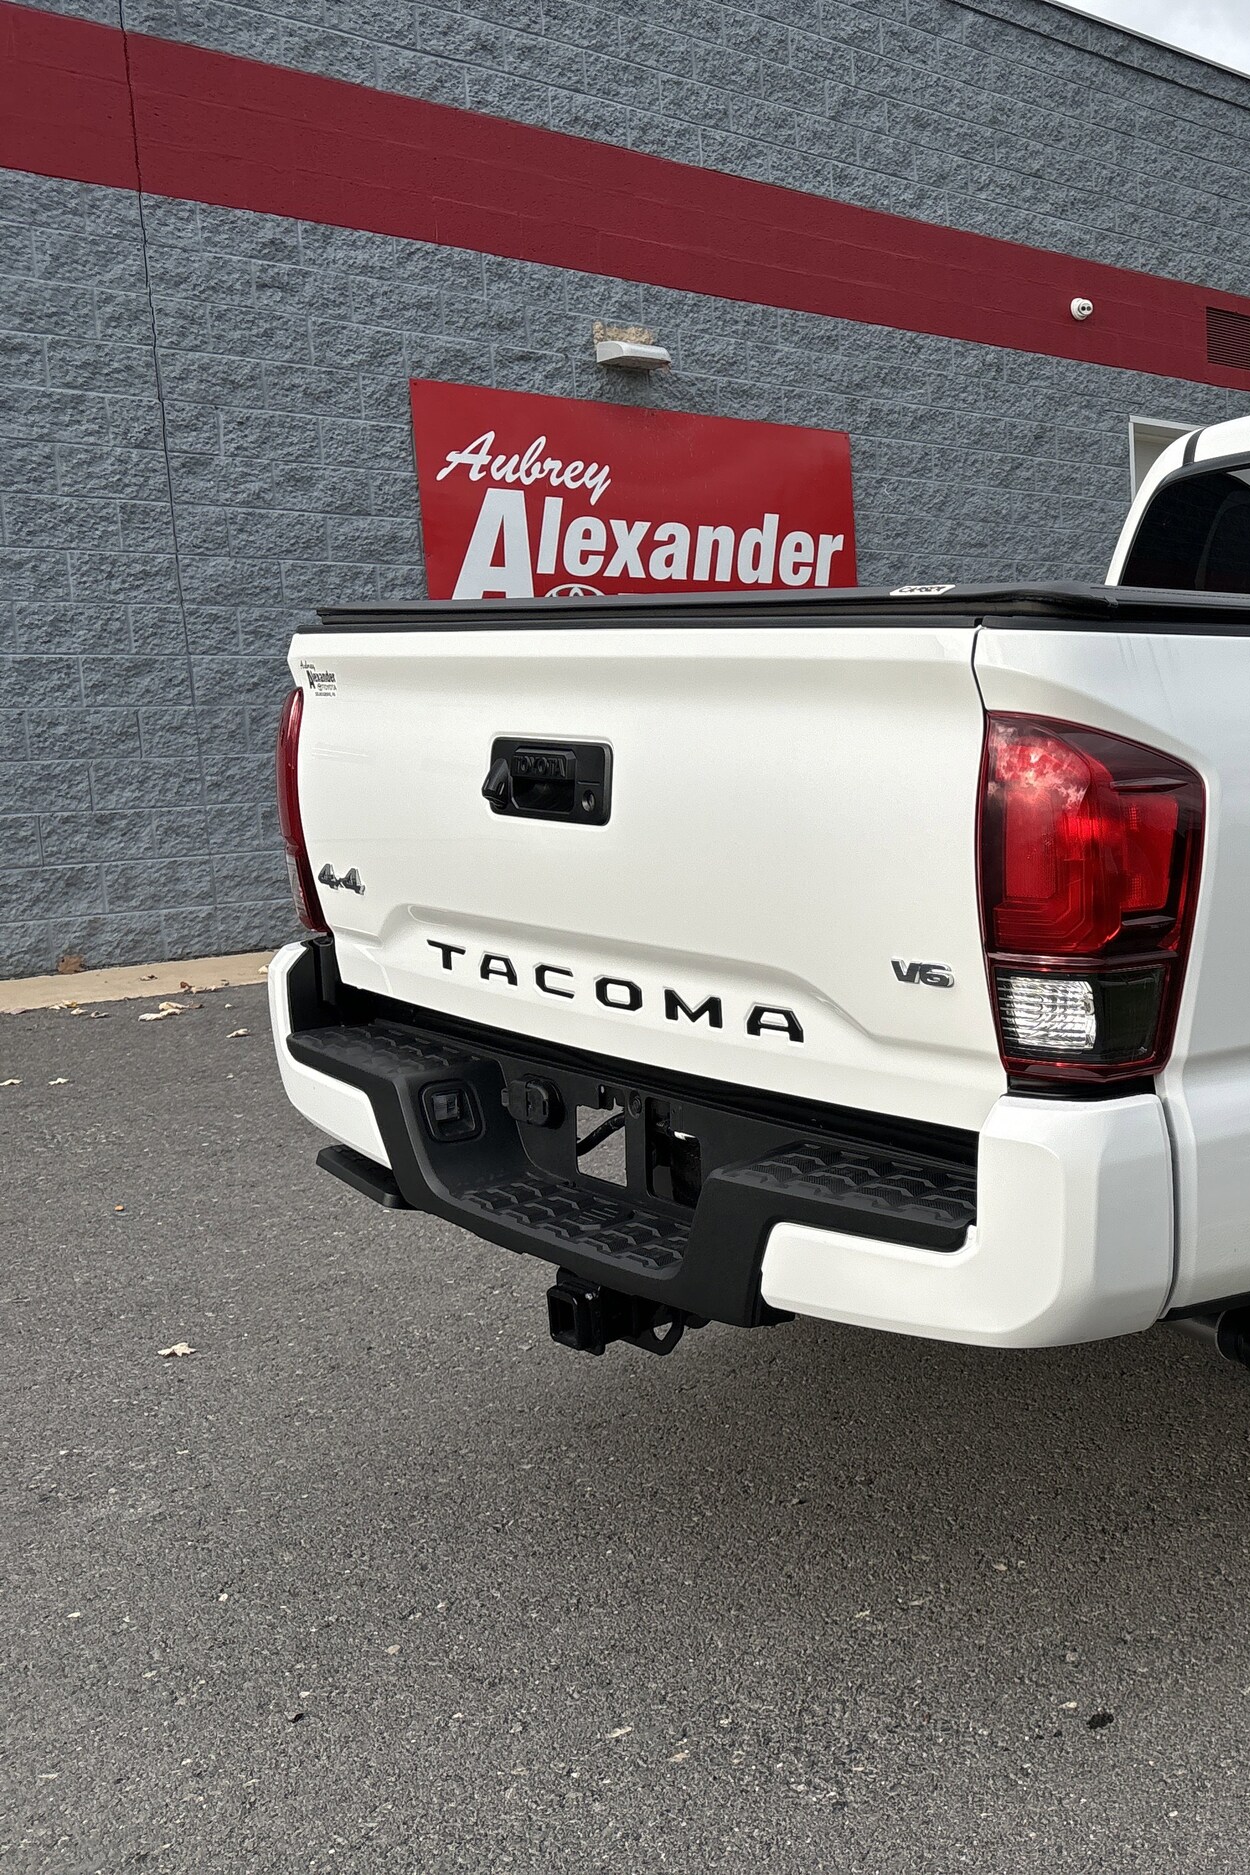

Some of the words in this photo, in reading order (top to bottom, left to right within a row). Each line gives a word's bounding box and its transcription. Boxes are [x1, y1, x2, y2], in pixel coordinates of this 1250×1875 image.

[435, 430, 612, 505] Aubrey
[452, 487, 844, 599] Alexander
[513, 755, 566, 778] TOYOTA
[426, 939, 805, 1043] TACOMA
[890, 958, 954, 988] V6
